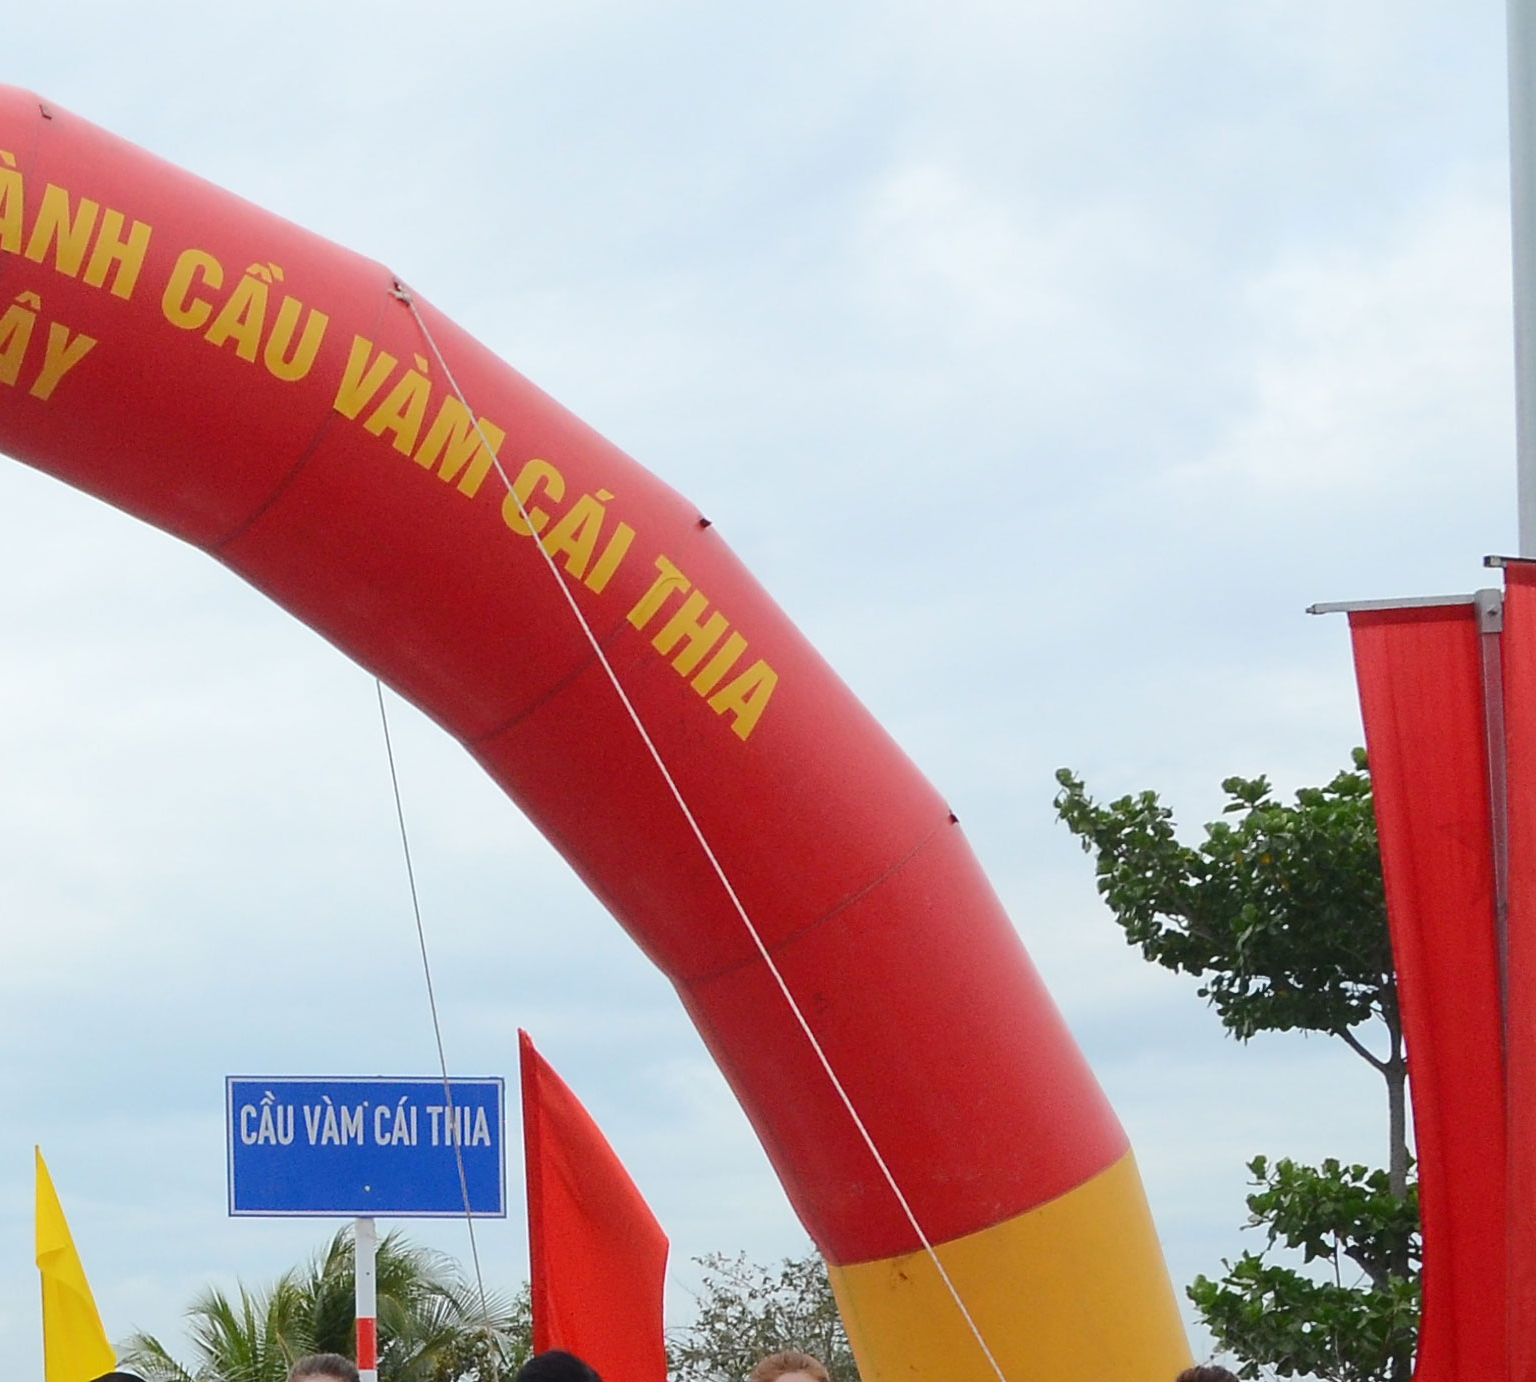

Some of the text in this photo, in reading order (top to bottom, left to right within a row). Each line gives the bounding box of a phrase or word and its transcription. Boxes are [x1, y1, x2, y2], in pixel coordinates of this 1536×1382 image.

[162, 248, 330, 382] CẦU
[333, 334, 506, 498] VÀM
[501, 458, 637, 594] CÁI
[626, 555, 780, 740] THIA
[240, 1090, 491, 1147] CẦU VÀM CÁI THIA
